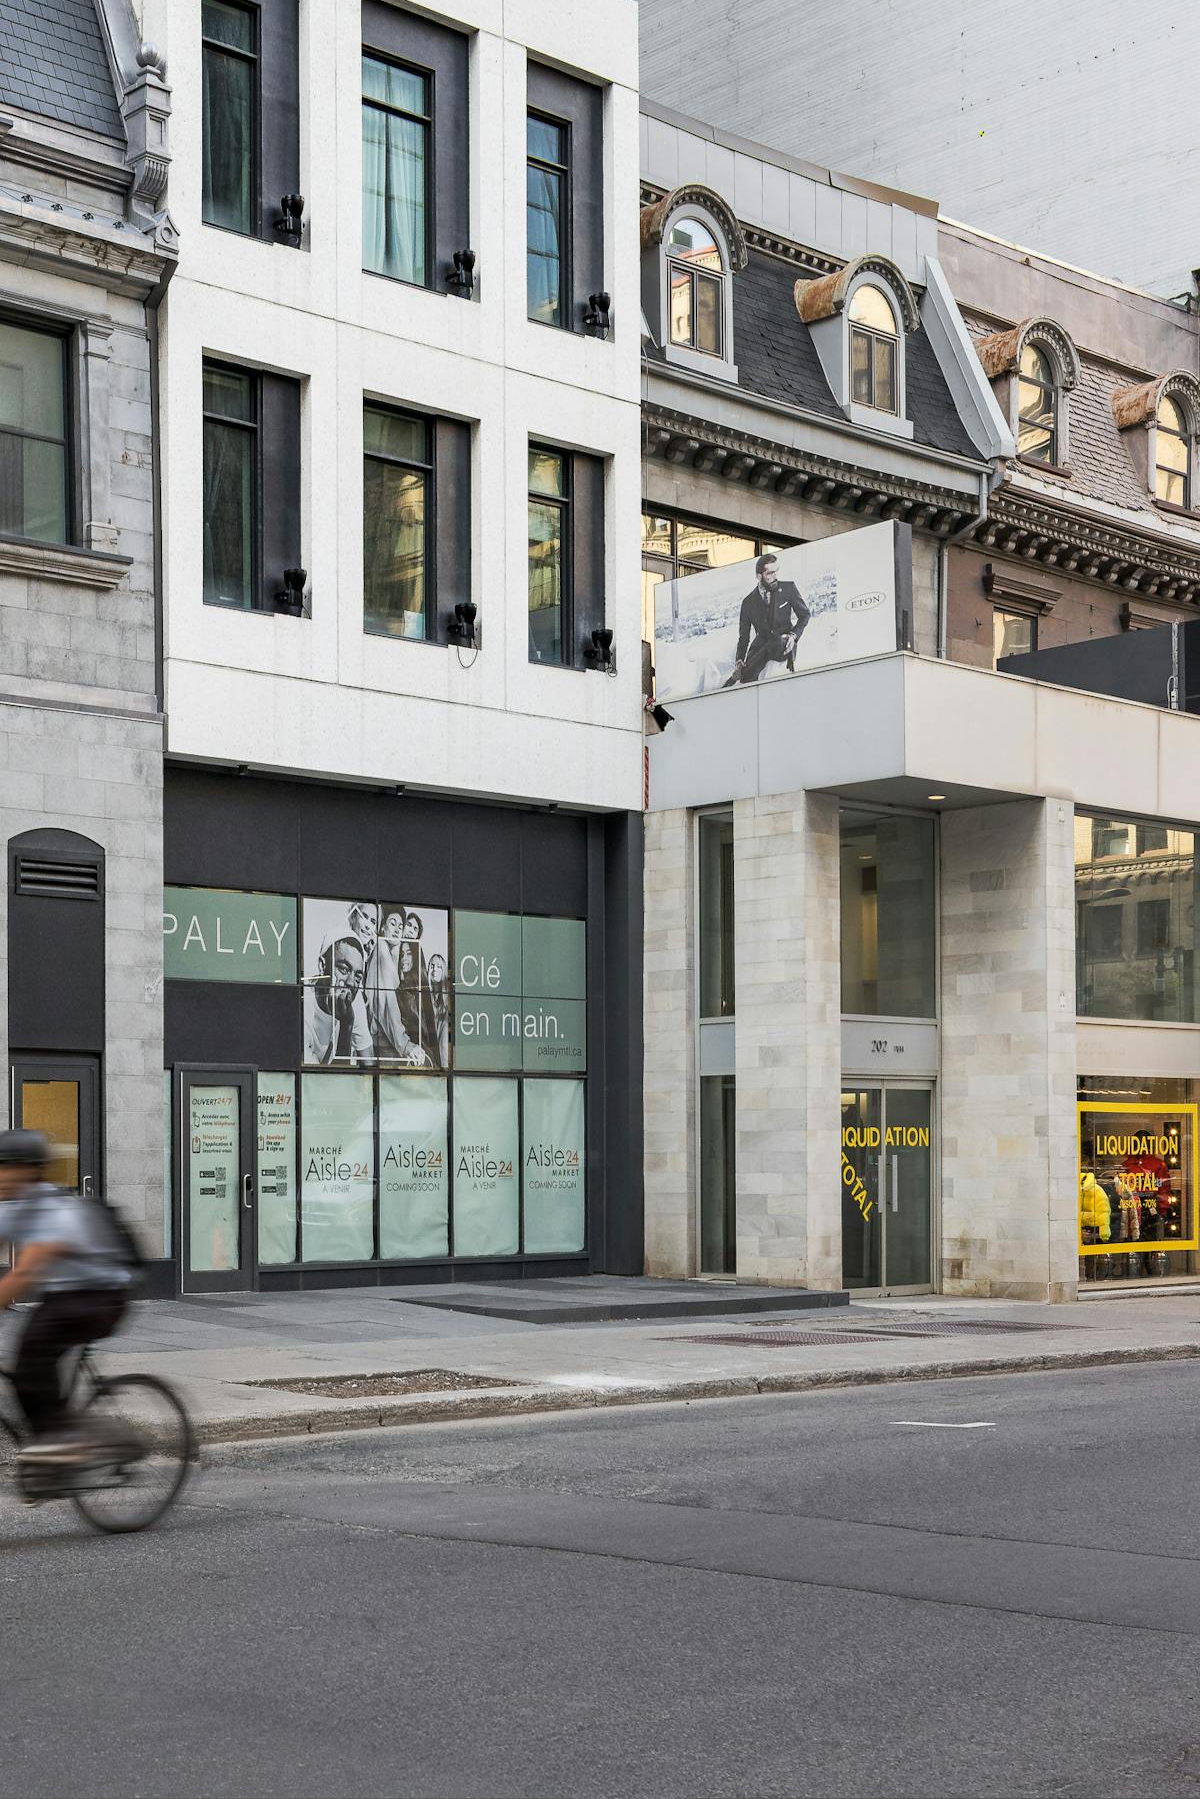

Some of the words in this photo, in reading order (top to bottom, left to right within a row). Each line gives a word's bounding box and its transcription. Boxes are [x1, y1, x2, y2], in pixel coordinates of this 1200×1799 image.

[851, 595, 880, 609] ETON
[162, 912, 290, 957] PALAY
[460, 955, 501, 988] Clé
[460, 1012, 490, 1036] en
[502, 1007, 565, 1039] main.
[537, 1045, 582, 1059] palaymtl.ca
[192, 1098, 217, 1106] OUVERT
[217, 1097, 232, 1106] 24/7
[257, 1095, 275, 1104] OPEN
[275, 1094, 292, 1105] 24/7
[842, 1126, 930, 1148] IQUIDATION
[309, 1144, 342, 1155] MARCHÉ
[460, 1144, 490, 1154] MARCHÉ
[1096, 1135, 1179, 1156] LIQUIDATION
[412, 1170, 443, 1179] MARKET
[551, 1168, 579, 1177] MARKET
[386, 1182, 418, 1192] COMING
[418, 1182, 440, 1192] SOON
[528, 1180, 558, 1190] COMING
[558, 1180, 577, 1190] SOON
[841, 1151, 873, 1222] TOTAL
[1119, 1172, 1159, 1192] TOTAL
[329, 1184, 351, 1194] VENIR
